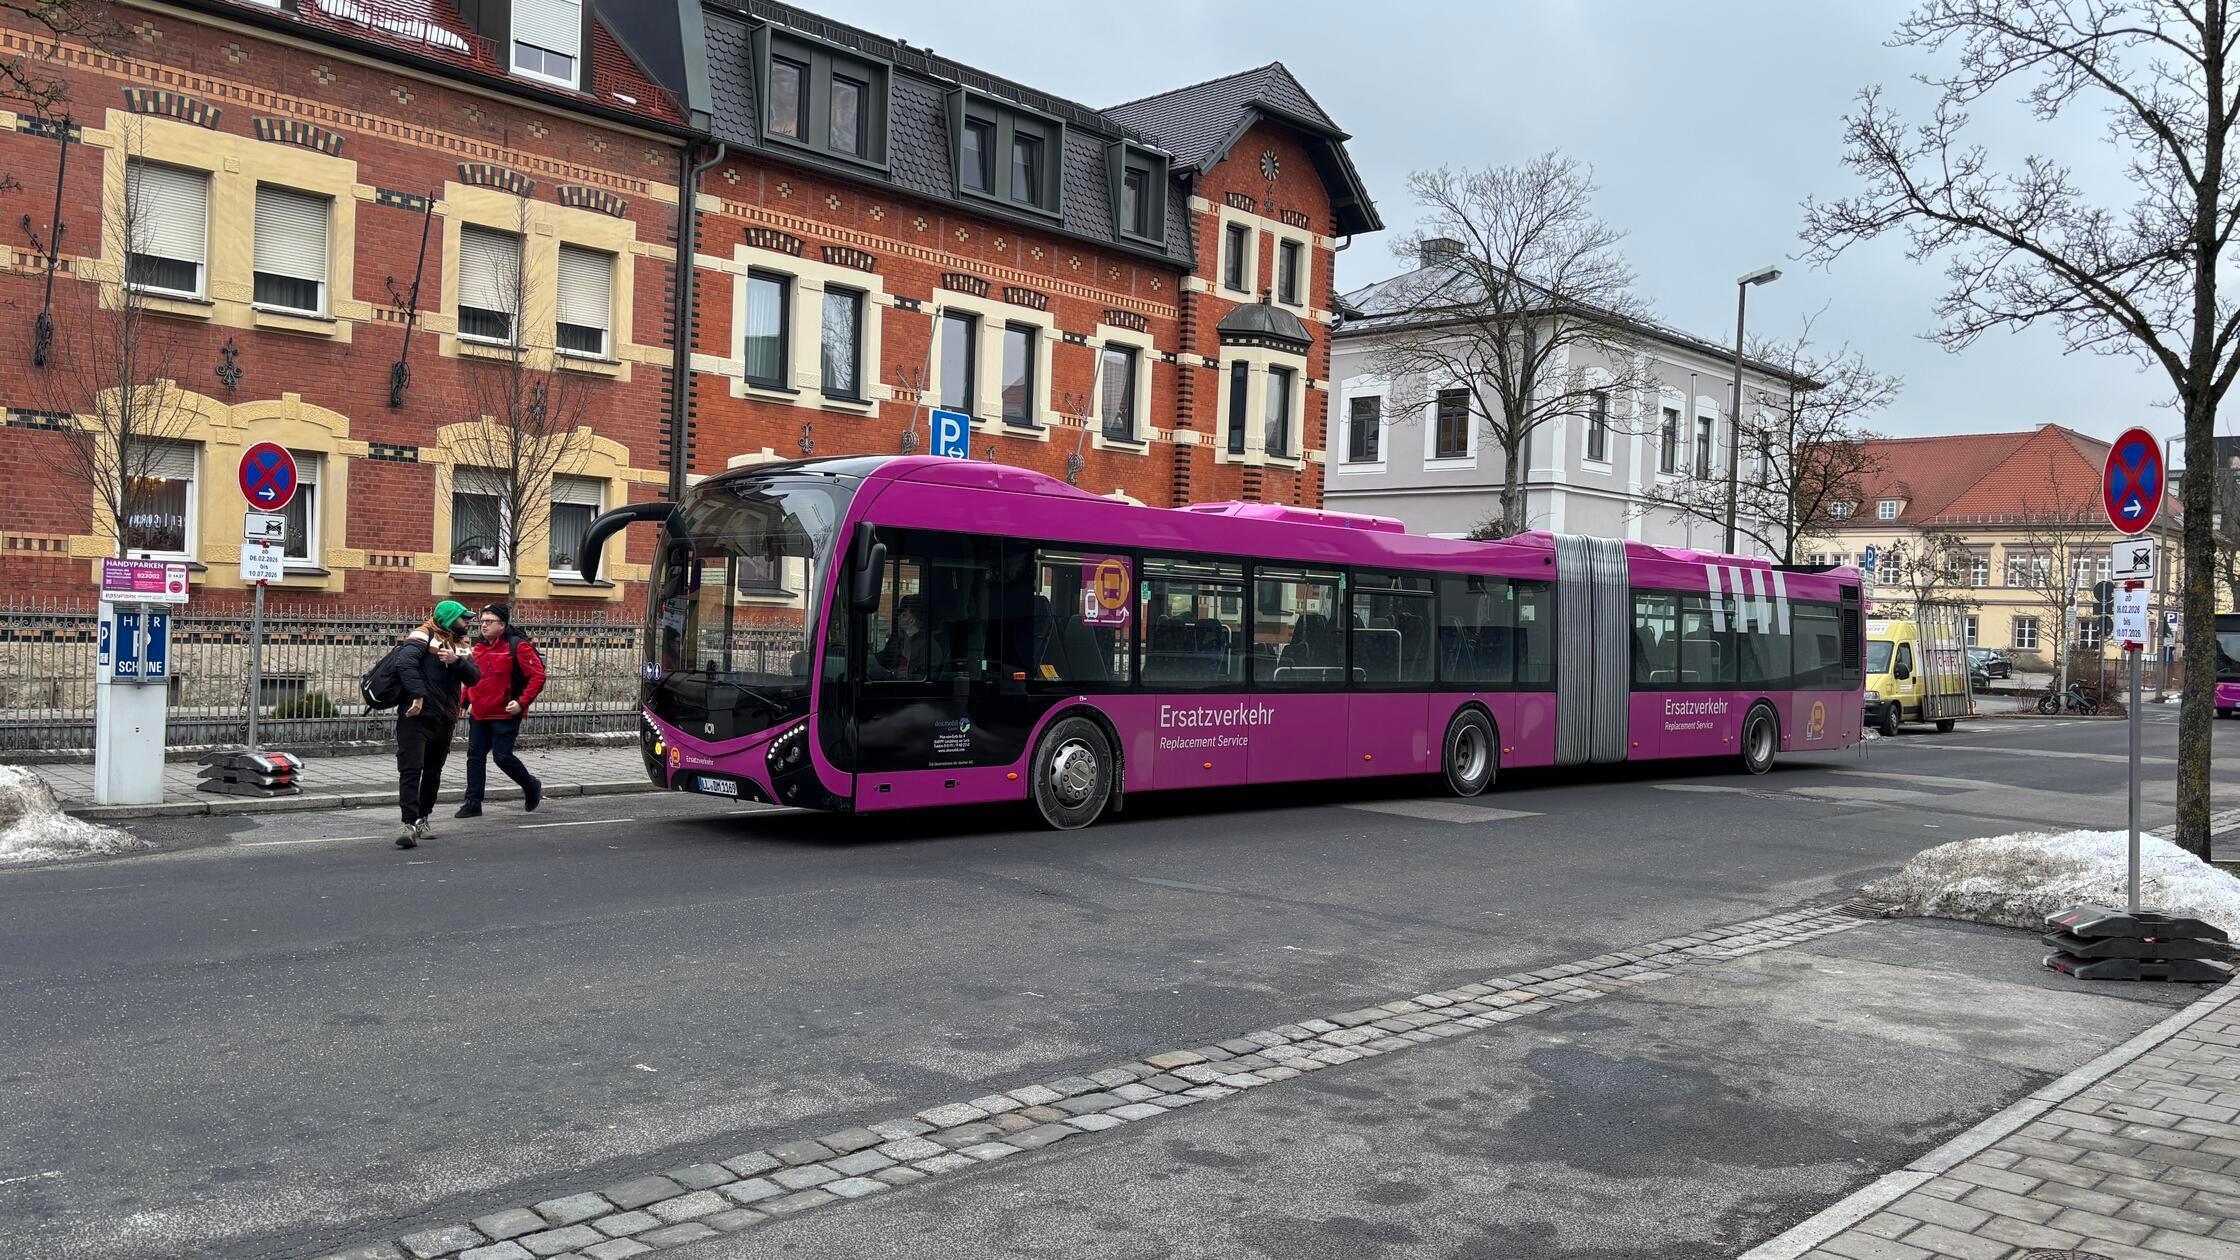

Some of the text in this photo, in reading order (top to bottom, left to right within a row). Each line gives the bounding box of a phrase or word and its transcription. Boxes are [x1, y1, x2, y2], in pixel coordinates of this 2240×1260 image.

[940, 417, 961, 456] P
[106, 560, 164, 569] HANDYPARKEN
[1867, 550, 1874, 568] P
[2125, 594, 2132, 602] ab
[2123, 617, 2131, 626] bis
[2167, 613, 2176, 622] P
[100, 626, 109, 647] P
[1665, 697, 1728, 715] Ersatzverkehr
[1160, 702, 1275, 728] Ersatzverkehr
[1664, 720, 1714, 732] Replacement Service
[1160, 735, 1249, 751] Replacement Service
[686, 755, 714, 766] Ersatzverkehr
